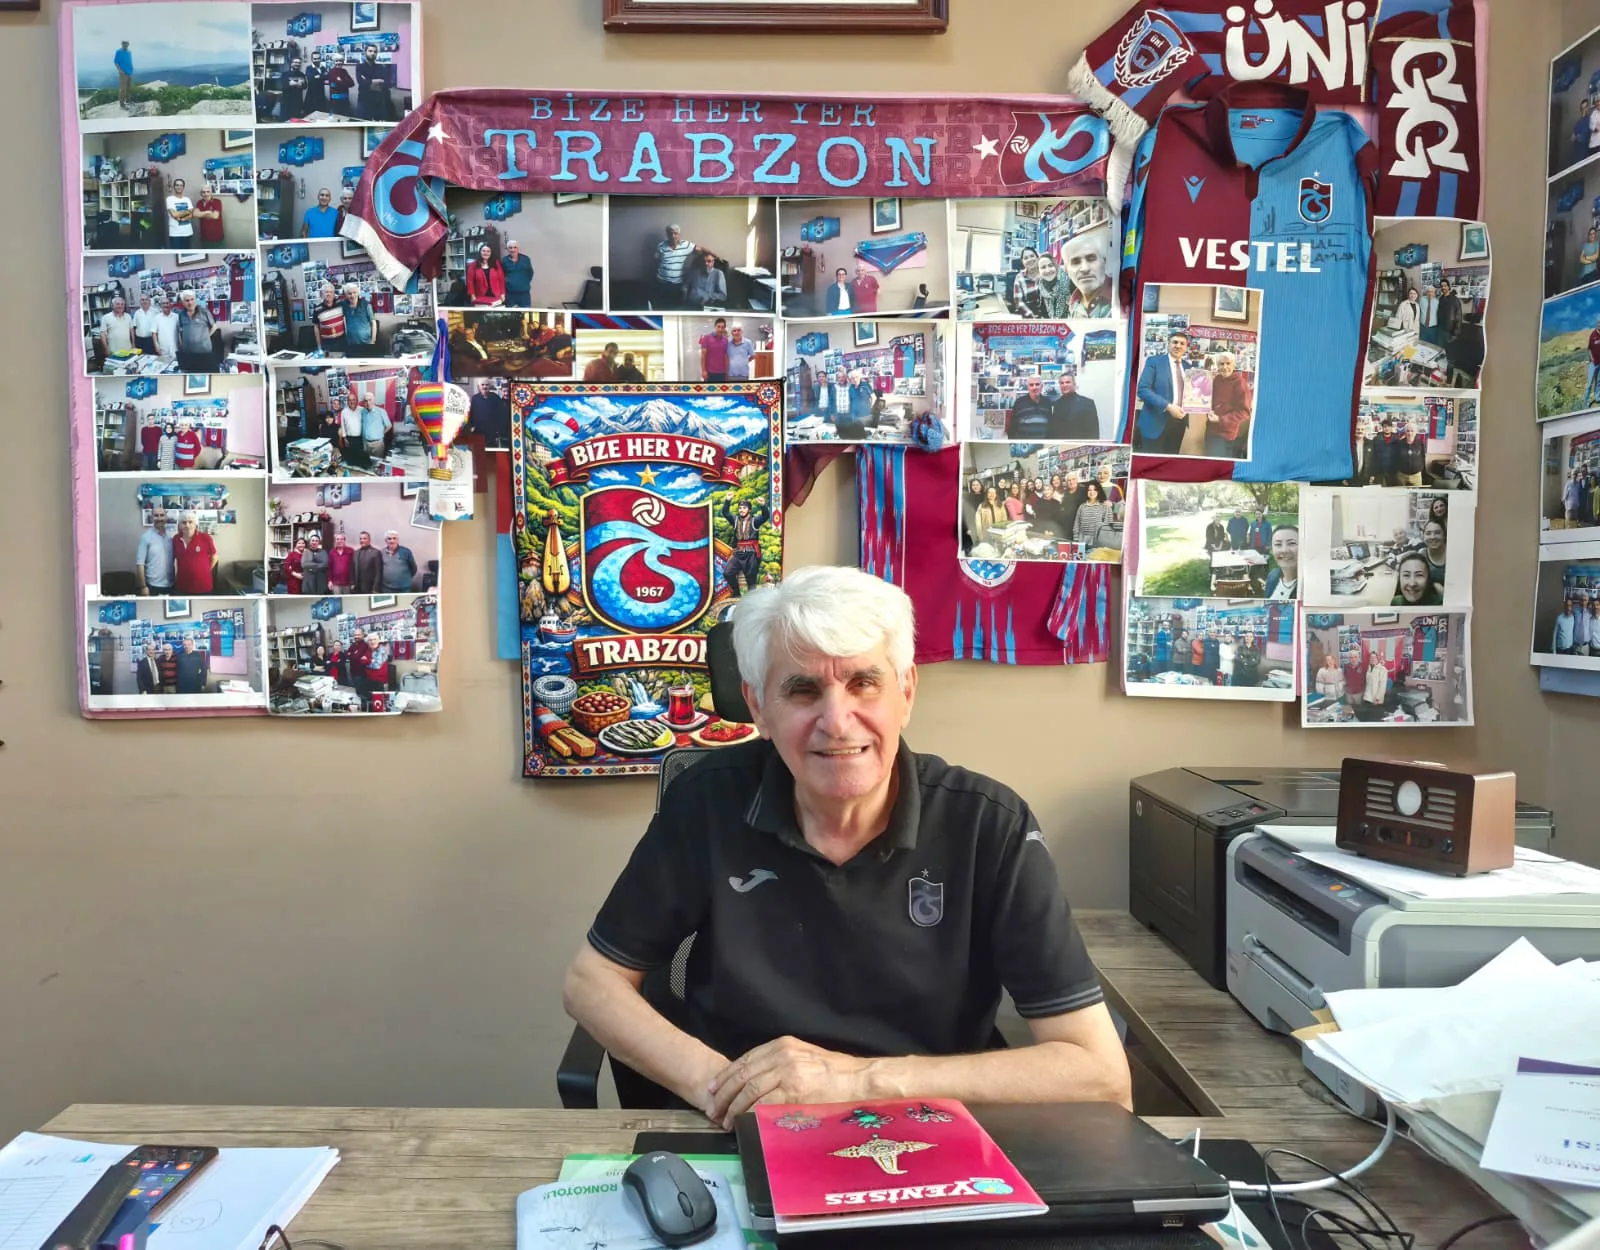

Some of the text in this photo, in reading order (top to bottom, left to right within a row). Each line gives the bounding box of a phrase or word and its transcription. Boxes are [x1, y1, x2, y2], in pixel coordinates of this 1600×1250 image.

[529, 92, 877, 127] BİZE HER YER
[484, 128, 938, 189] TRABZON
[1178, 237, 1321, 274] VESTEL
[569, 437, 718, 466] BİZE HER YER
[635, 586, 665, 598] 1967
